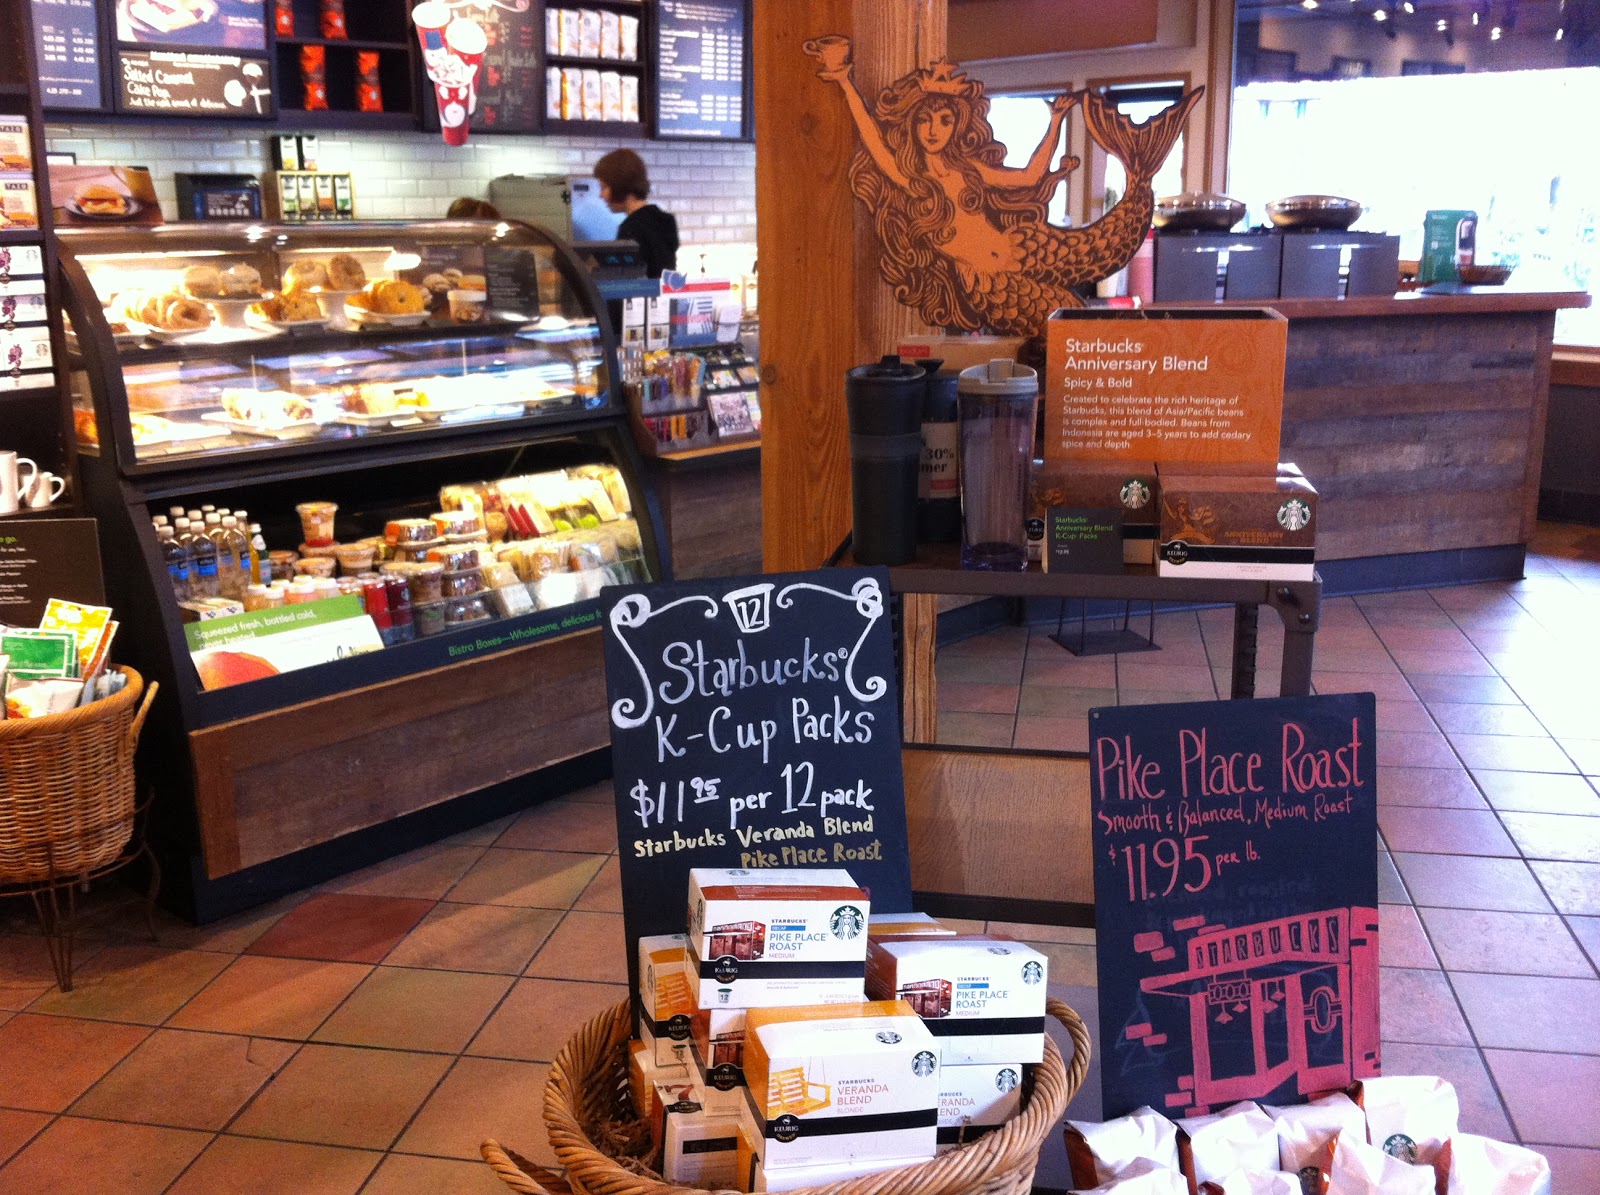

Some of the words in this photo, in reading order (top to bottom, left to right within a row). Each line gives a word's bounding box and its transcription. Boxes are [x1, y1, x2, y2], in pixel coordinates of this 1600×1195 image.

[1065, 338, 1143, 353] Starbucks
[1065, 357, 1158, 374] Anniversary
[1162, 356, 1209, 371] Blend
[1063, 377, 1093, 389] Spicy
[1096, 379, 1105, 388] &
[1107, 378, 1133, 388] Bold
[1063, 395, 1098, 404] Created
[1100, 396, 1109, 404] to
[1111, 395, 1152, 404] celebrate
[1154, 396, 1168, 404] the
[1171, 395, 1187, 404] rich
[1189, 395, 1227, 407] heritage
[1229, 396, 1239, 405] of
[1109, 407, 1124, 416] this
[1126, 407, 1152, 416] blend
[1154, 407, 1163, 416] of
[1166, 407, 1215, 417] Asia/Pacific
[1217, 408, 1244, 417] beans
[1071, 418, 1108, 427] complex
[1110, 418, 1126, 426] and
[1181, 419, 1206, 428] Beans
[1209, 418, 1231, 428] from
[1062, 429, 1103, 438] Indonesia
[1105, 430, 1119, 438] are
[1121, 429, 1144, 440] aged
[1164, 431, 1187, 441] years
[1190, 430, 1199, 439] to
[1201, 430, 1219, 439] add
[1062, 440, 1084, 450] spice
[1086, 440, 1101, 449] and
[1055, 525, 1095, 533] Anniversary
[737, 598, 764, 629] 12
[194, 623, 238, 640] Squeezed
[264, 614, 295, 626] bottled
[448, 644, 474, 657] Bistro
[561, 614, 595, 628] delicious
[655, 706, 777, 764] K-Cup
[792, 695, 875, 744] Packs
[1097, 735, 1166, 801] Pike
[1180, 727, 1265, 798] Place
[1282, 717, 1364, 794] Roast
[730, 790, 773, 830] per
[780, 761, 817, 814] 12
[820, 779, 875, 818] pack
[1255, 796, 1309, 829] Medium
[1314, 790, 1354, 823] Roast
[634, 828, 727, 859] Starbucks
[736, 821, 815, 849] Veranda
[823, 814, 874, 836] Blend
[740, 849, 780, 869] Pike
[782, 843, 828, 866] Place
[833, 838, 883, 862] Roast
[769, 933, 792, 942] PIKE
[795, 933, 827, 942] PLACE
[769, 942, 803, 951] ROAST
[956, 991, 977, 999] PIKE
[979, 990, 1009, 999] PLACE
[956, 1000, 987, 1009] ROAST
[837, 1084, 889, 1096] VERANDA
[837, 1096, 872, 1106] BLEND
